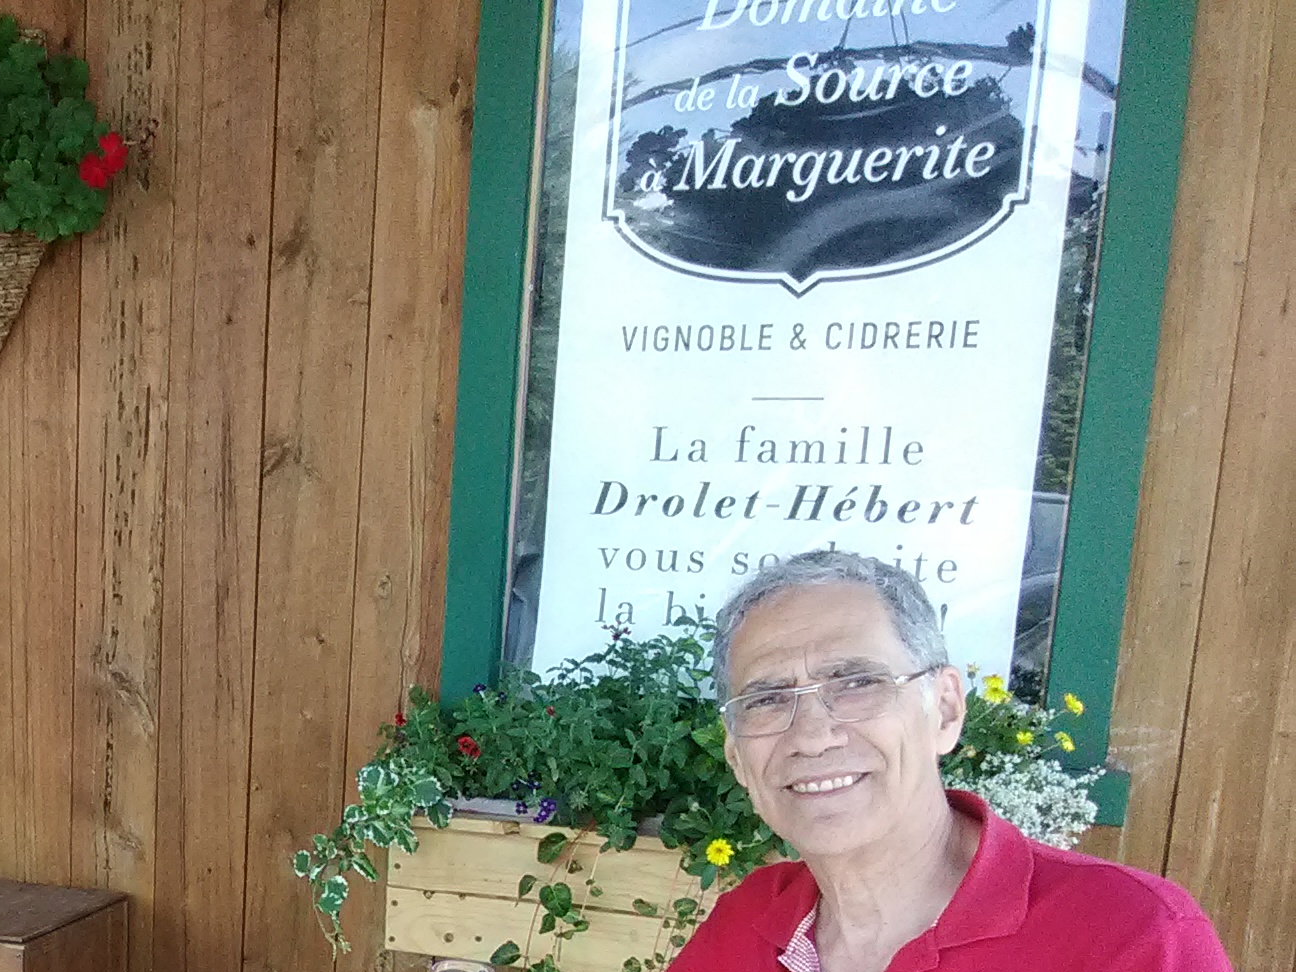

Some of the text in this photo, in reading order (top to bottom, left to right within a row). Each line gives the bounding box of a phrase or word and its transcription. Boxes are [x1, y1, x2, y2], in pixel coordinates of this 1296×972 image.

[674, 52, 973, 112] de la Source
[640, 126, 995, 202] à Marguerite
[622, 320, 981, 352] VIGNOBLE & CIDRERIE
[650, 425, 925, 466] La famille
[590, 480, 980, 526] Drolet-Hébert
[598, 541, 958, 583] vous soite
[594, 587, 635, 625] la
